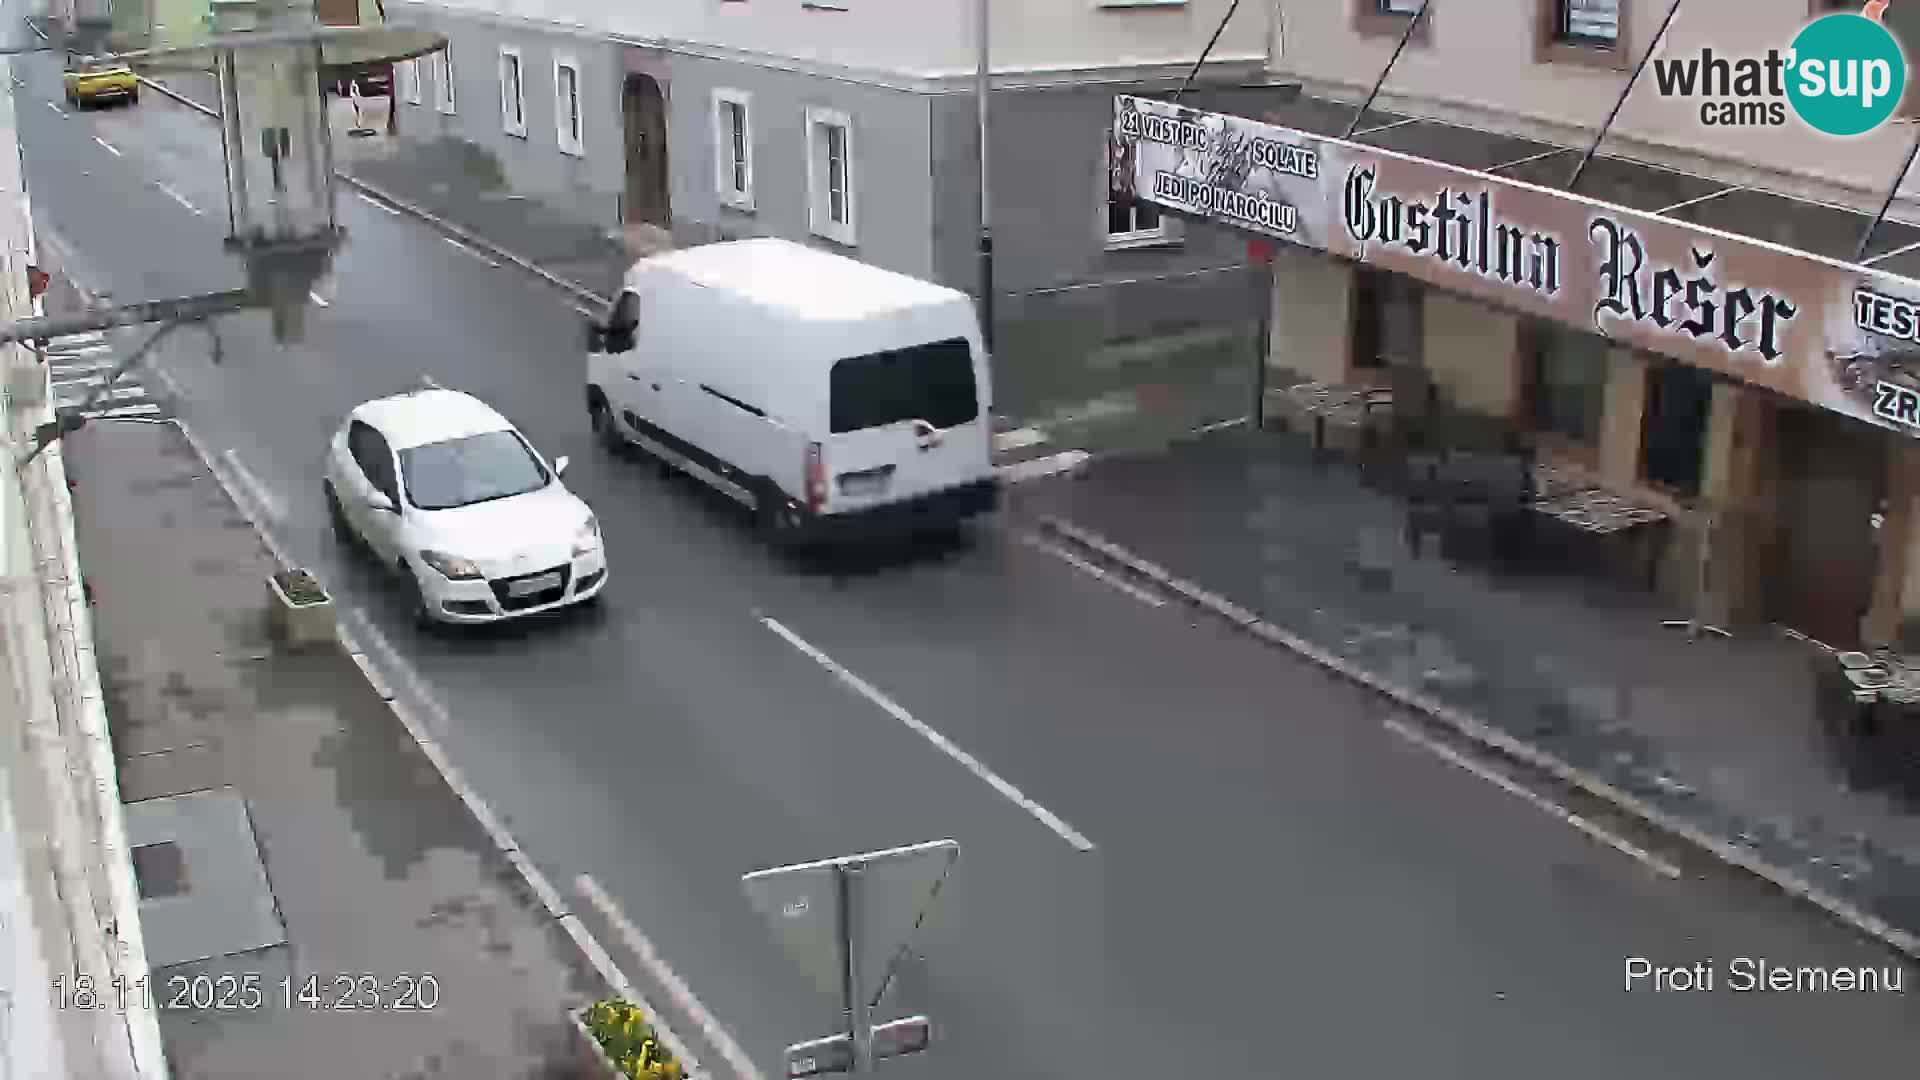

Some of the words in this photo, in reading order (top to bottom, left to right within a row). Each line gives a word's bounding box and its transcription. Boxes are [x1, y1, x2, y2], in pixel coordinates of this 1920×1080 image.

[1121, 112, 1139, 135] 21
[1251, 138, 1318, 178] SOLATE
[1154, 171, 1186, 201] JEDI
[1188, 181, 1211, 207] PO
[1344, 162, 1561, 296] Gostilna
[1588, 216, 1798, 362] Rešer
